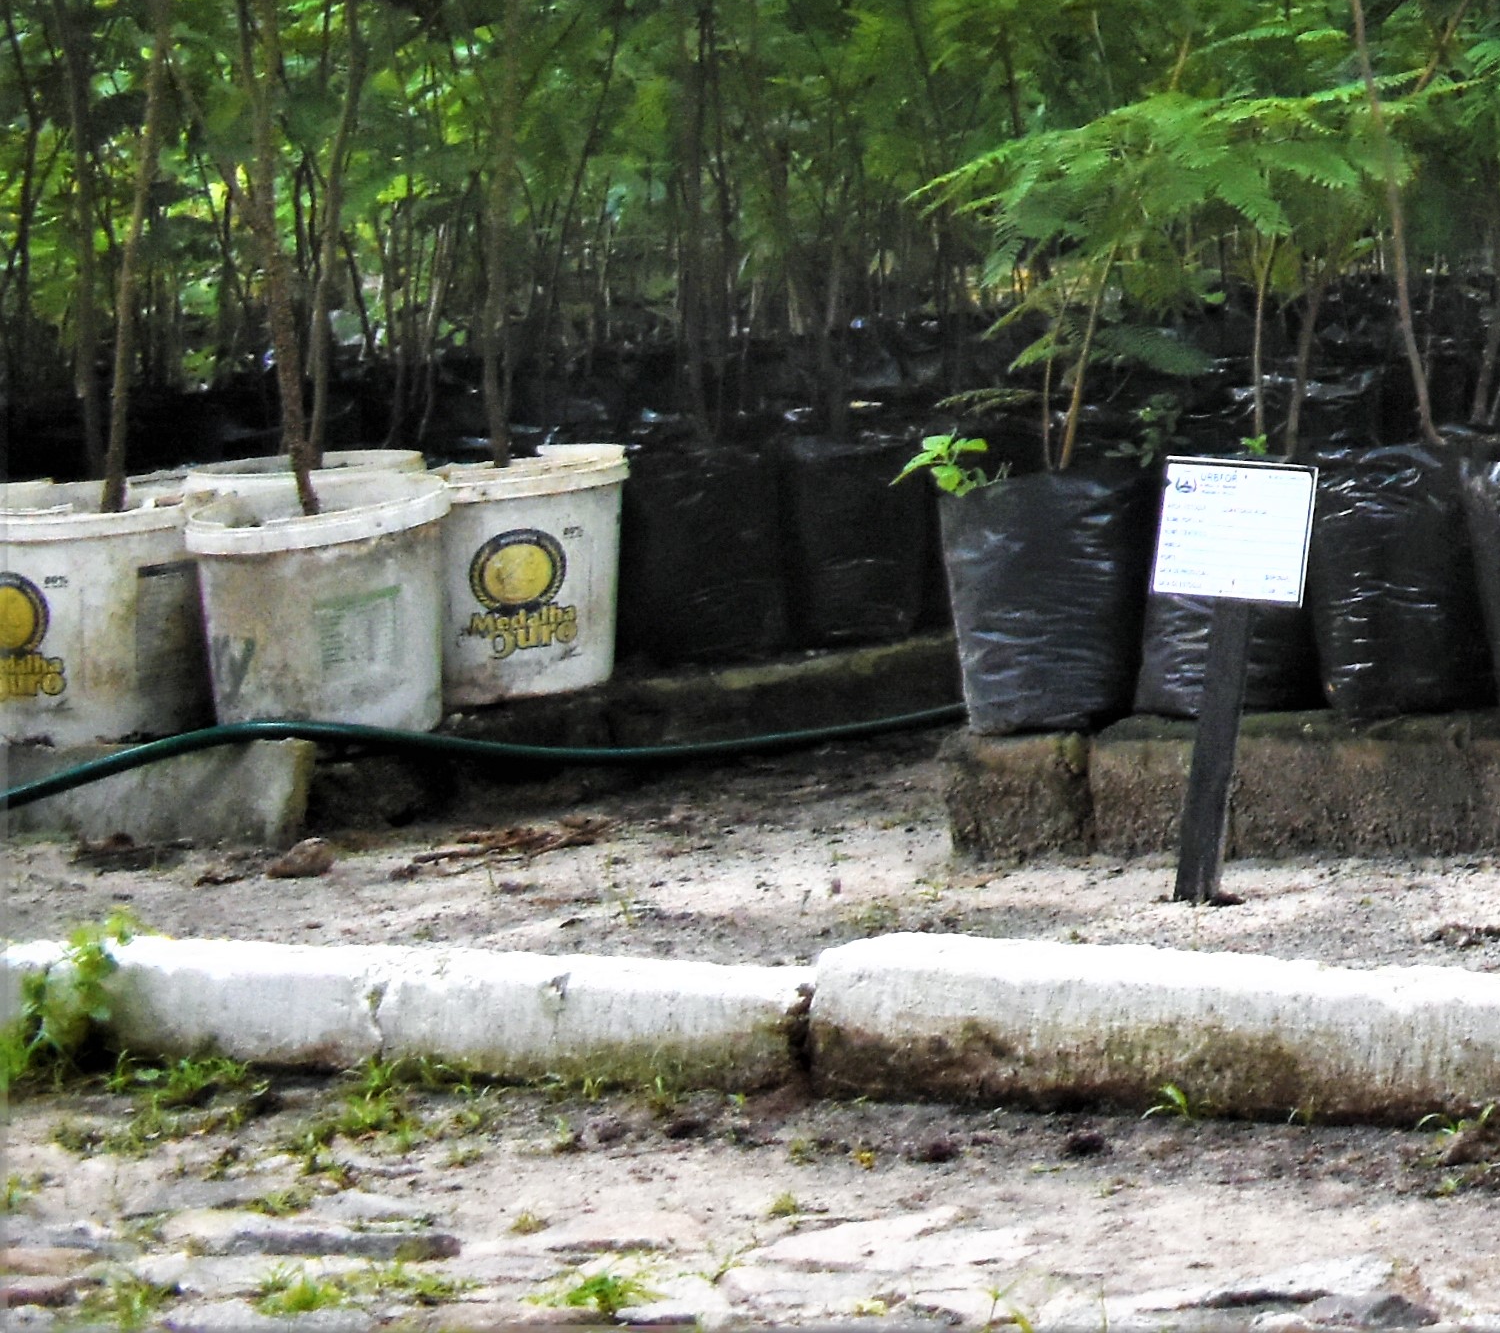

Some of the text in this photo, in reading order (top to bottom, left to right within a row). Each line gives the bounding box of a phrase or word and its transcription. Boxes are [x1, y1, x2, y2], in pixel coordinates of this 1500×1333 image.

[469, 603, 578, 637] Medalha
[488, 621, 578, 660] Ouro
[0, 671, 67, 702] uro
